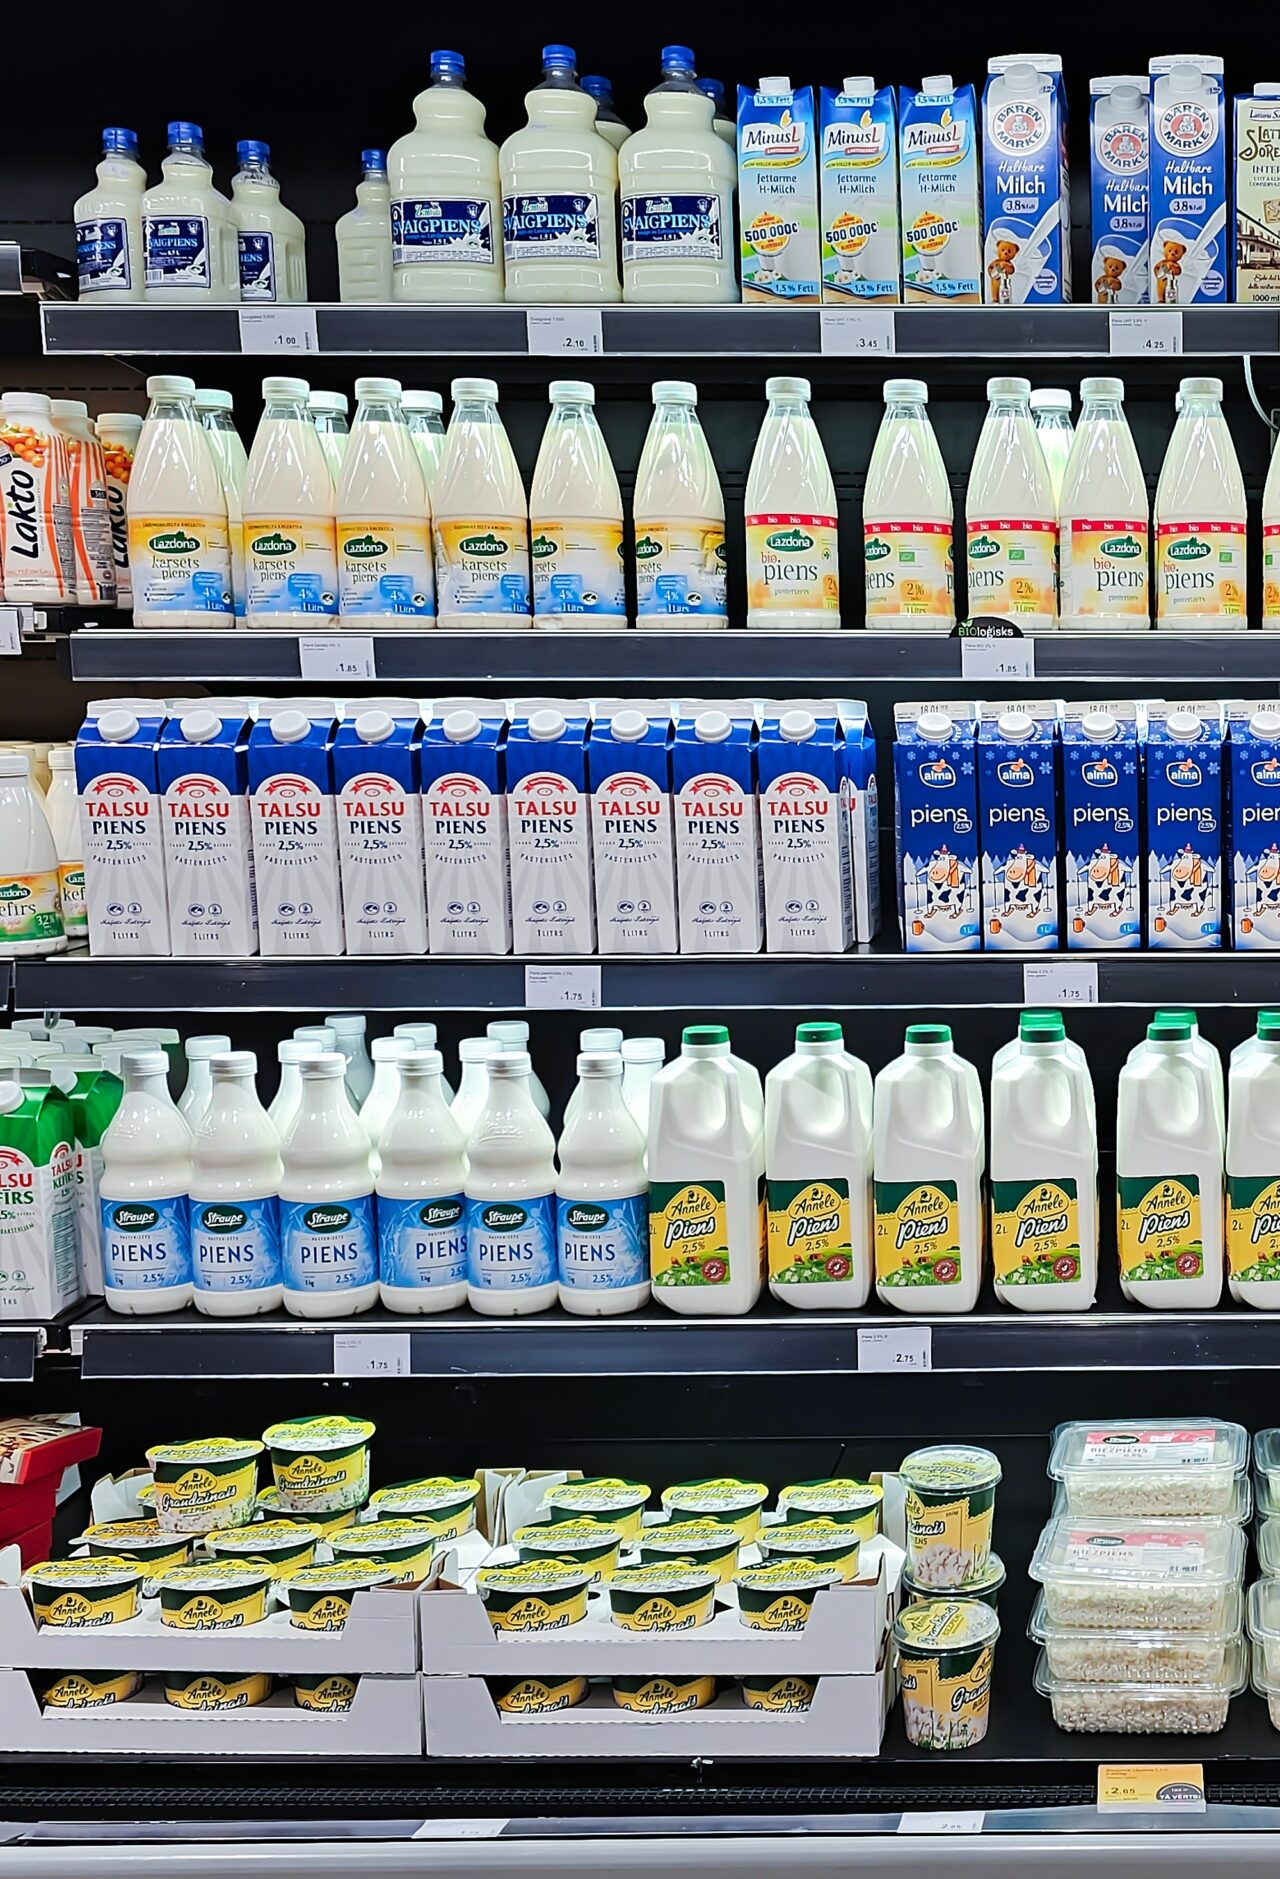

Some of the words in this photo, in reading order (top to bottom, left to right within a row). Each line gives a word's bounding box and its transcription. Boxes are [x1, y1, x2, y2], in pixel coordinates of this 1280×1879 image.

[997, 103, 1042, 122] BÄREN
[1165, 103, 1209, 122] BÄREN
[746, 129, 800, 147] MinusL
[827, 128, 880, 147] MinusL
[908, 128, 960, 147] MinusL
[997, 129, 1042, 148] MARKE
[1165, 131, 1209, 149] MARKE
[757, 173, 797, 185] fettarme
[996, 174, 1046, 195] Milch
[1164, 175, 1213, 196] Milch
[759, 184, 795, 194] H-Milch
[10, 469, 37, 560] Lakto
[154, 538, 197, 550] Lazdona
[463, 539, 505, 553] Lazdona
[770, 536, 810, 549] Lazdona
[1108, 542, 1141, 555] Lazdona
[1170, 543, 1208, 556] Lazdona
[152, 556, 199, 570] karsets
[462, 558, 507, 572] karsets
[764, 560, 818, 585] piens
[1097, 565, 1143, 591] piens
[1166, 568, 1214, 594] piens
[925, 769, 952, 780] alma
[1087, 769, 1114, 781] alma
[86, 801, 148, 817] TALSU
[258, 802, 321, 818] TALSU
[515, 801, 576, 816] TALSU
[911, 803, 967, 827] piens
[1073, 803, 1129, 826] piens
[93, 821, 146, 836] PIENS
[264, 821, 318, 836] PIENS
[521, 820, 573, 833] PIENS
[569, 1209, 606, 1225] Straupe
[672, 1200, 710, 1217] Annele
[903, 1200, 943, 1218] Annele
[116, 1210, 155, 1226] Straupe
[308, 1210, 348, 1227] Straupe
[664, 1215, 716, 1249] Piens
[896, 1216, 948, 1249] Piens
[112, 1243, 166, 1262] PIENS
[301, 1242, 357, 1264] PIENS
[565, 1242, 615, 1262] PIENS
